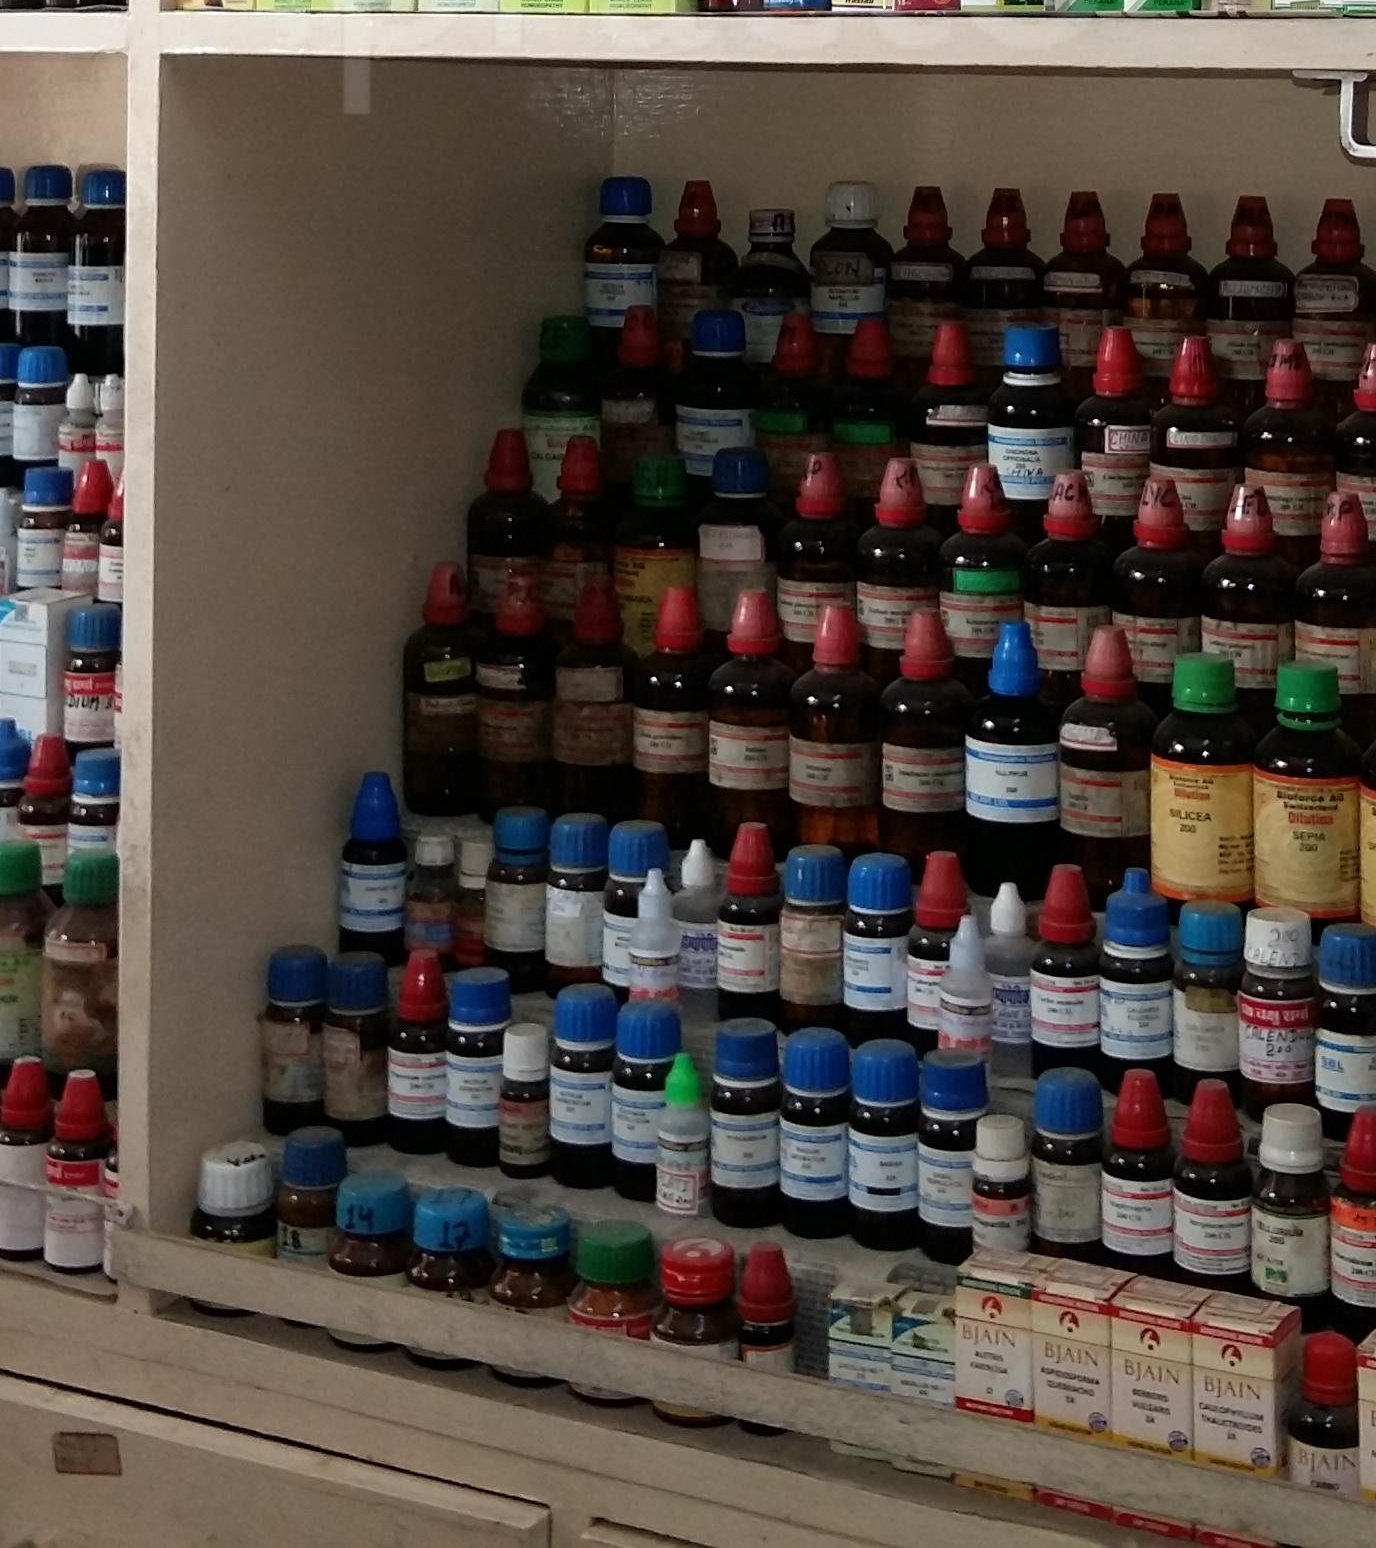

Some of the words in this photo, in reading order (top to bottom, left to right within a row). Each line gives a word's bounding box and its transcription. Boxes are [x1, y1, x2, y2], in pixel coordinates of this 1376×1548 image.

[1277, 791, 1325, 802] Bioforce
[1329, 792, 1344, 802] AG
[1283, 802, 1338, 811] Switzerland
[1169, 809, 1212, 822] SILICEA
[1288, 812, 1334, 825] Dilution
[1180, 824, 1196, 834] 200
[1292, 831, 1326, 841] SEPIA
[1299, 843, 1318, 852] 200
[961, 1324, 1017, 1348] BJAIN
[1044, 1341, 1099, 1367] BJAIN
[1124, 1359, 1180, 1384] BJAIN
[1204, 1376, 1261, 1400] BJAIN
